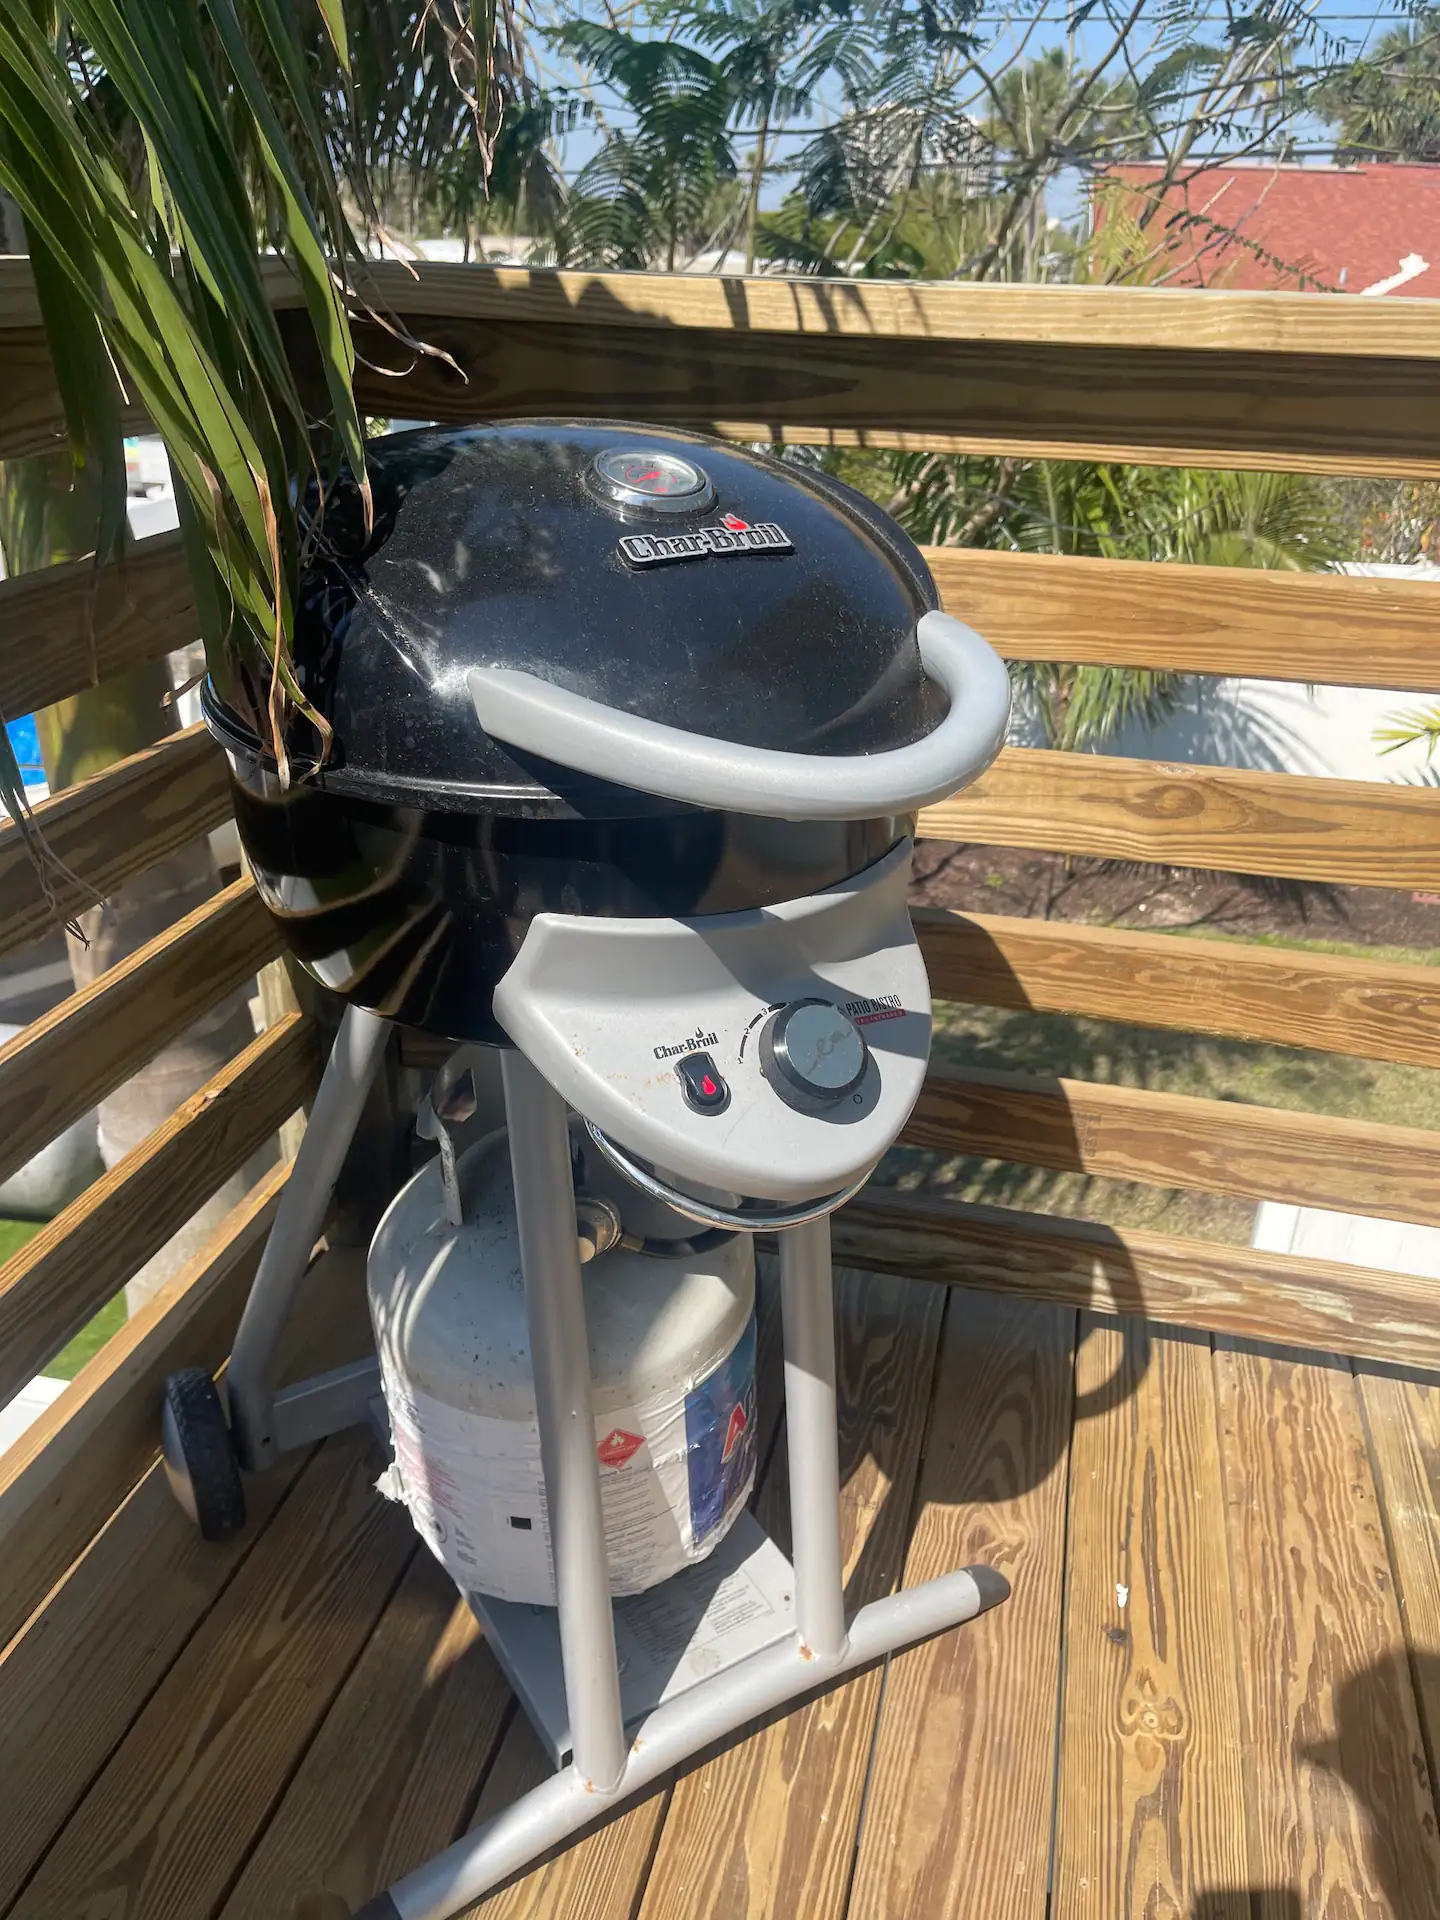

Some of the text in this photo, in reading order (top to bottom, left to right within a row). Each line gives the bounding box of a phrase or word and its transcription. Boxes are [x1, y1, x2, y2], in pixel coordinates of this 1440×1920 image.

[621, 523, 789, 561] Char-Broil
[761, 1007, 768, 1015] 3
[845, 994, 902, 1016] PATIO BISTRO
[653, 1032, 719, 1060] Char-Broil
[737, 1057, 744, 1065] 1
